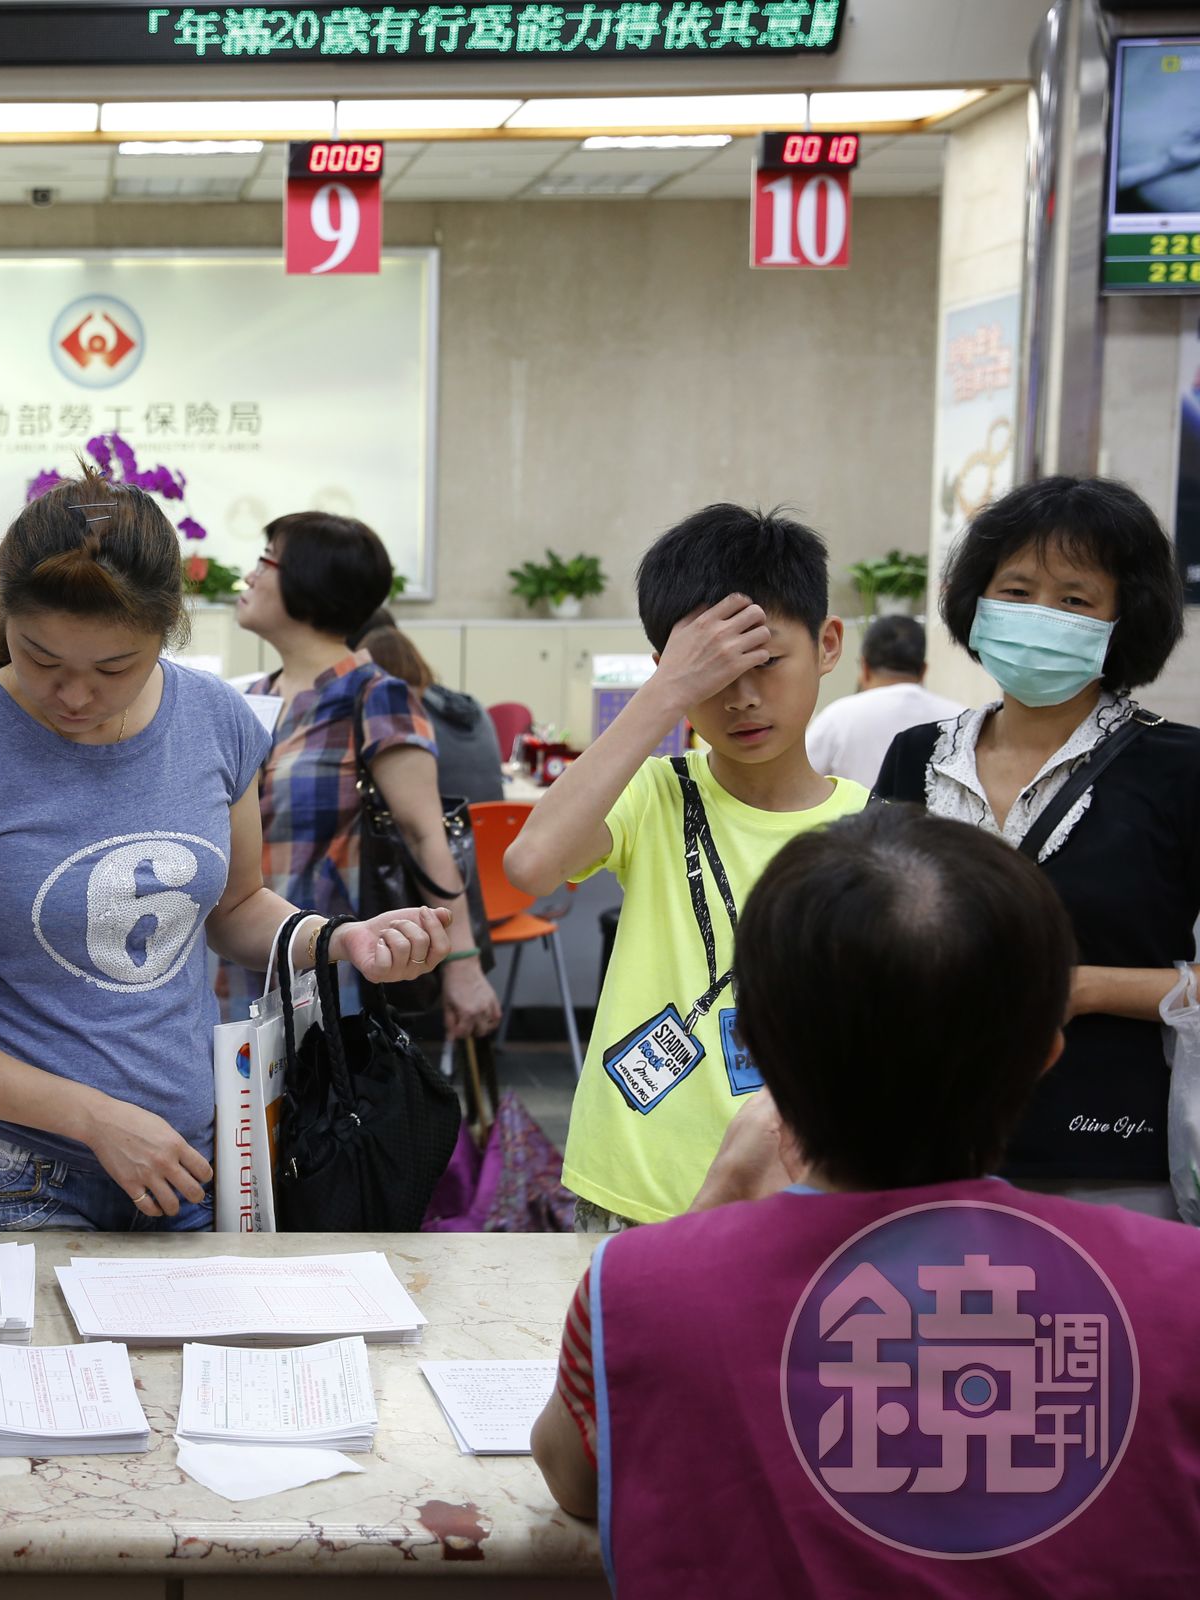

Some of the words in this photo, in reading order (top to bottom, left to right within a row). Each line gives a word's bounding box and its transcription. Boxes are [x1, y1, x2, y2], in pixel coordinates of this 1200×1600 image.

[309, 144, 382, 173] 0009
[783, 136, 858, 164] 0010
[310, 182, 361, 275] 9
[762, 174, 847, 266] 10
[86, 840, 200, 984] 6
[655, 1023, 693, 1068] STADIUM
[618, 1063, 639, 1090] WEEKEND
[636, 1088, 650, 1102] PASS
[664, 1058, 682, 1077] GIG
[1068, 1114, 1110, 1132] Olive
